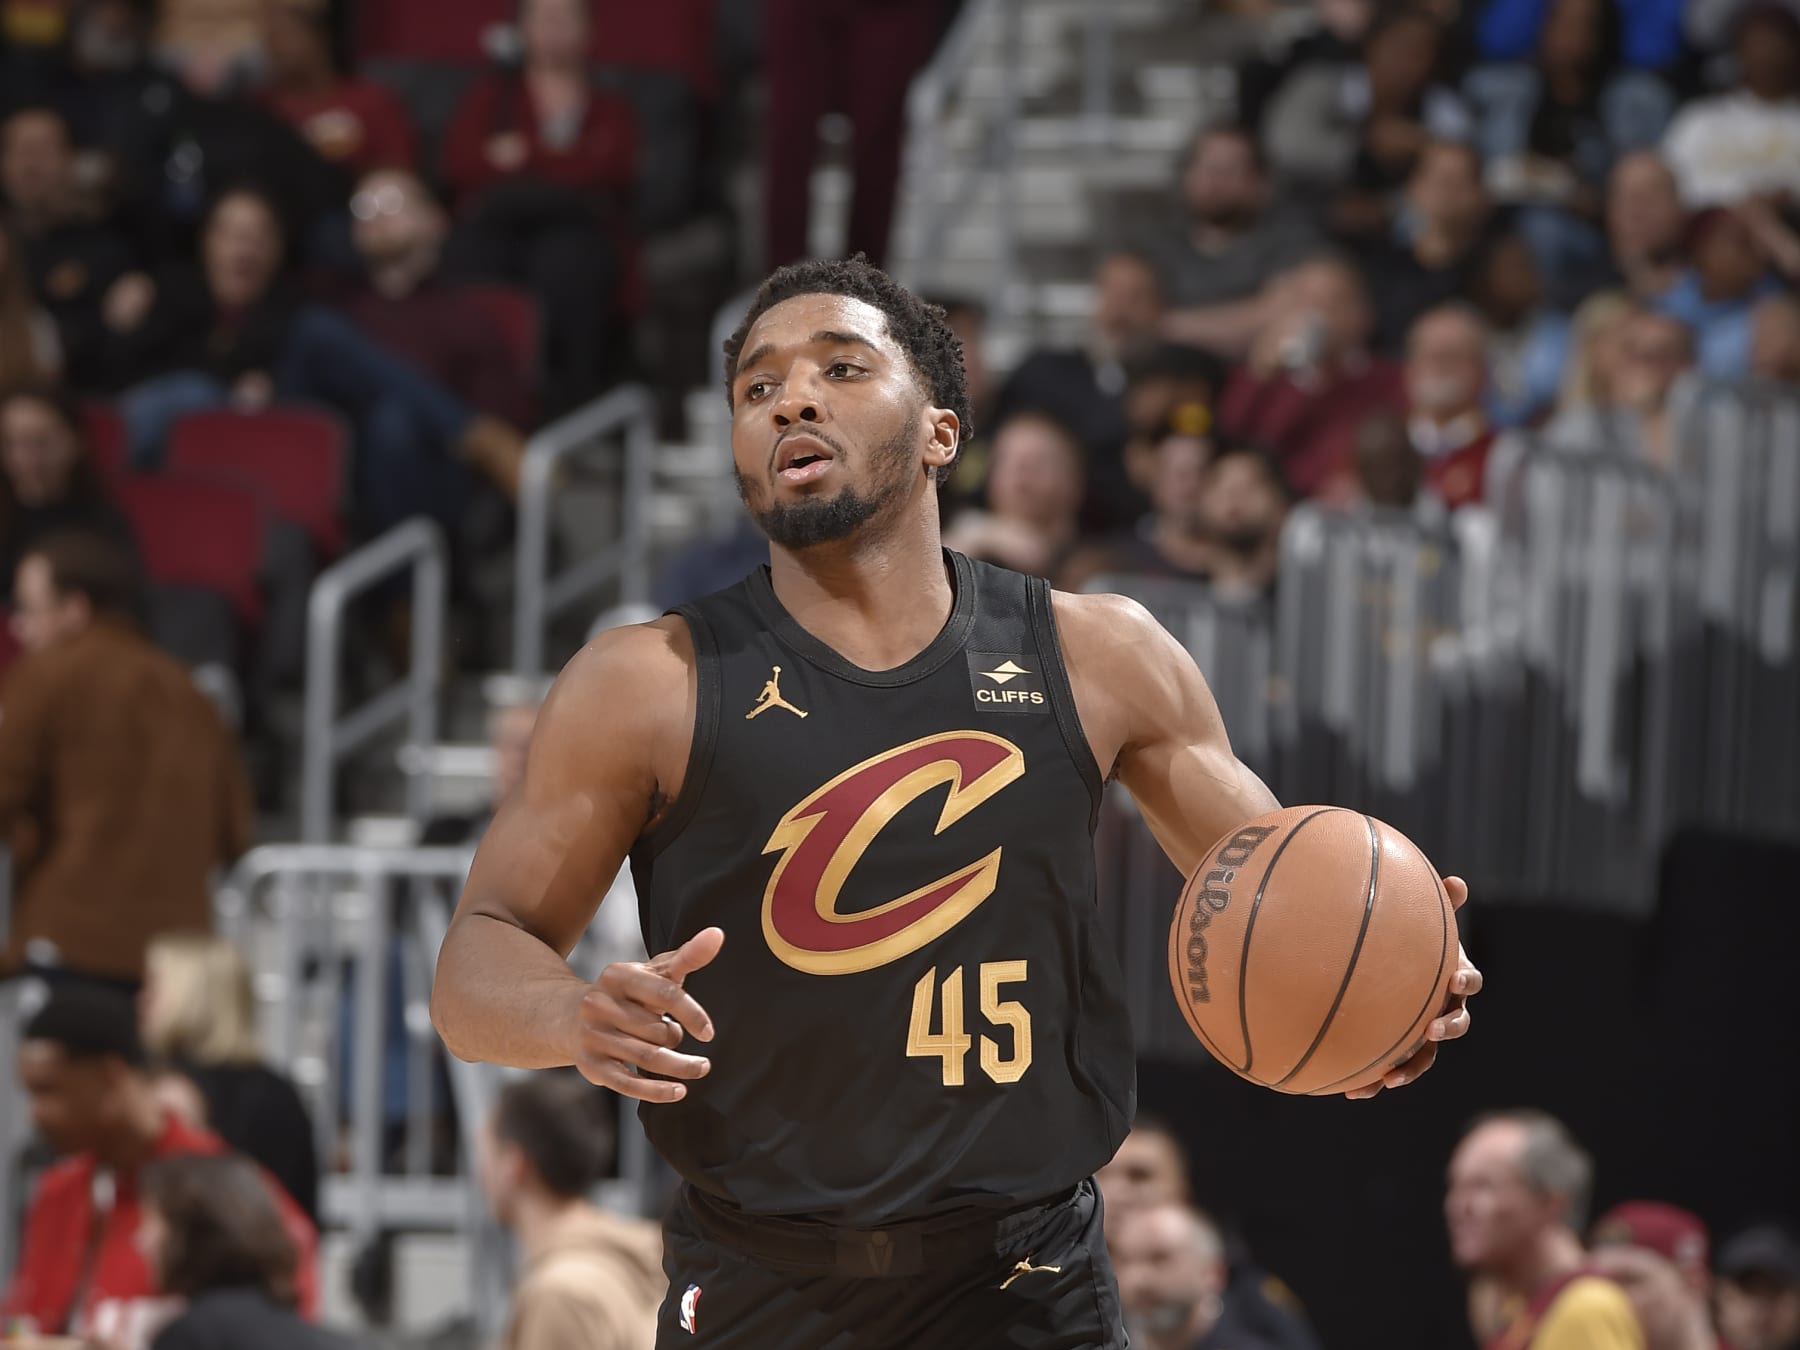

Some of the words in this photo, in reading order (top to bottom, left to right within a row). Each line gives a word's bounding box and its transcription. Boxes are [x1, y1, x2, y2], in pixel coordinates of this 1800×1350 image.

[976, 689, 1044, 704] CLIFFS
[1187, 825, 1279, 1004] Wilson
[906, 959, 1033, 1086] 45
